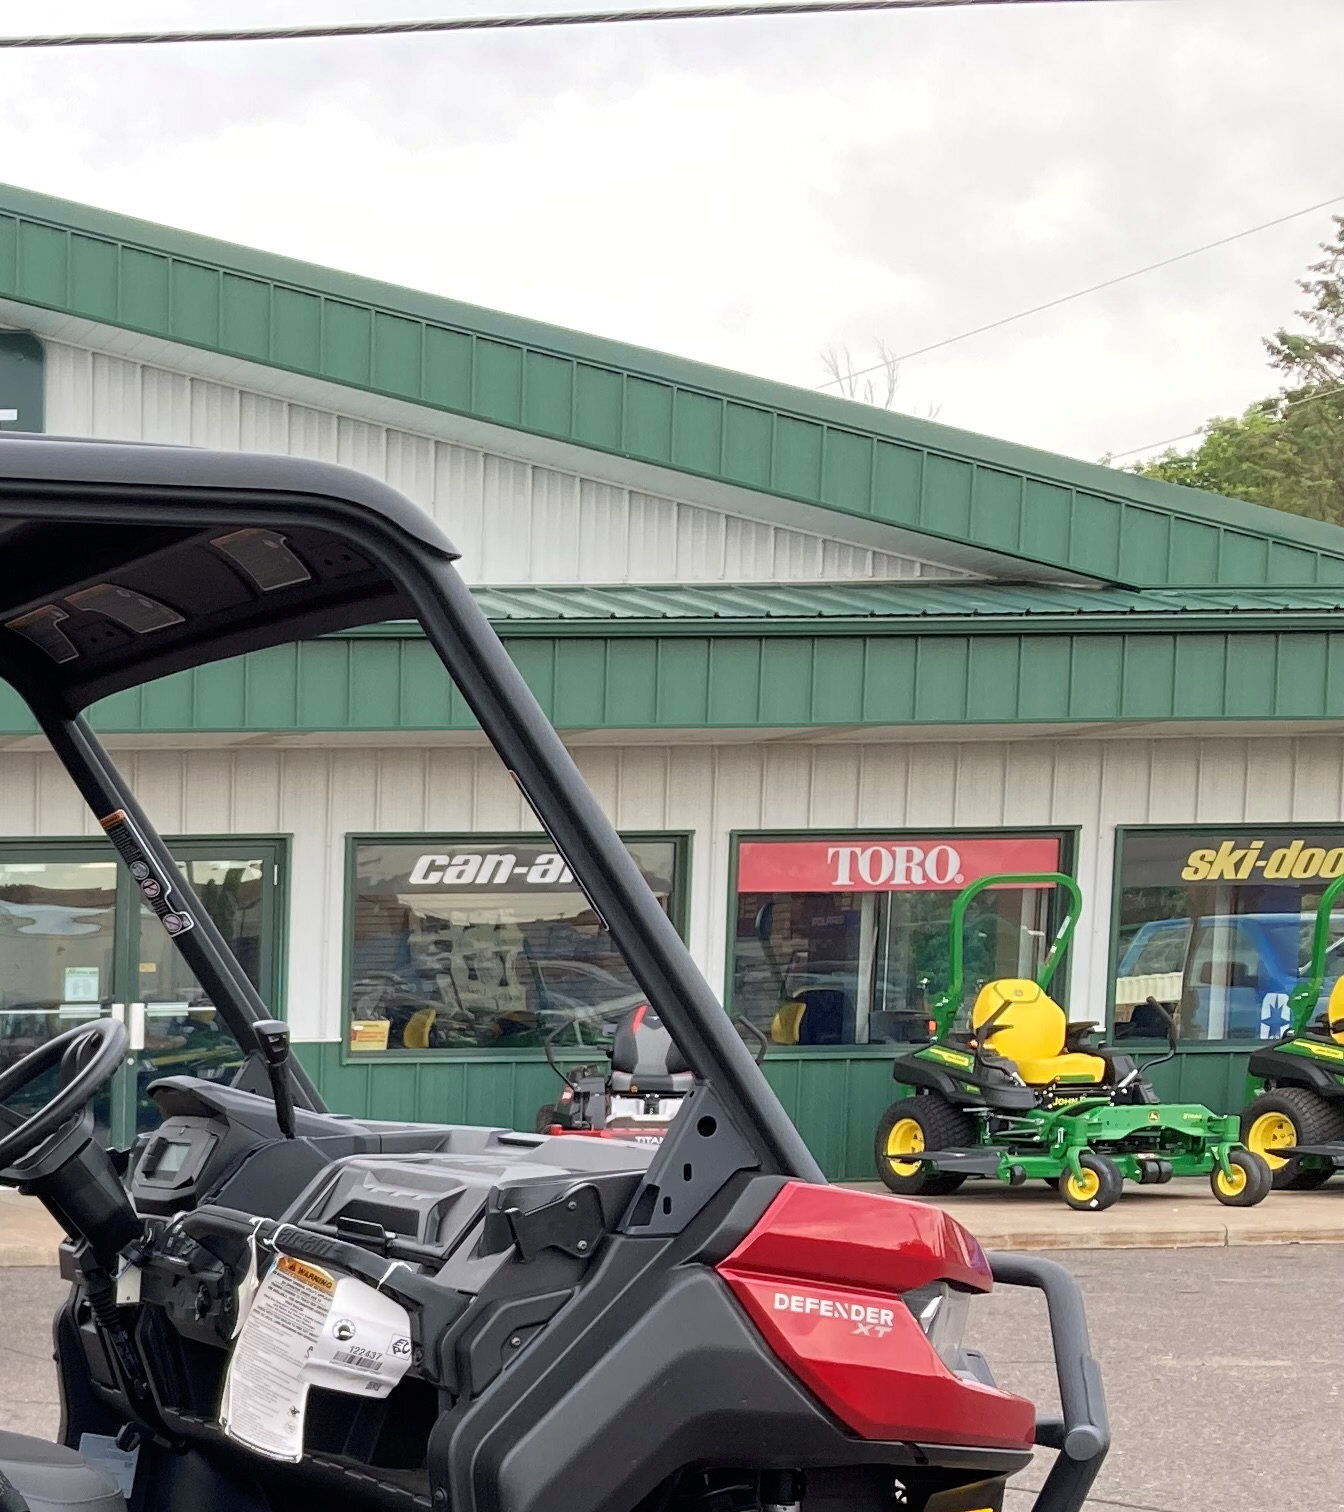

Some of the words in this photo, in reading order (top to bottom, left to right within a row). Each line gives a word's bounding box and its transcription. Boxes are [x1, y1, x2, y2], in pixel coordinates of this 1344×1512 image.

[827, 845, 961, 886] TORO
[1181, 840, 1344, 881] ski-doo
[297, 1264, 333, 1290] WARNING
[773, 1292, 895, 1327] DEFENDER
[851, 1323, 893, 1339] XT
[350, 1345, 383, 1361] 122437
